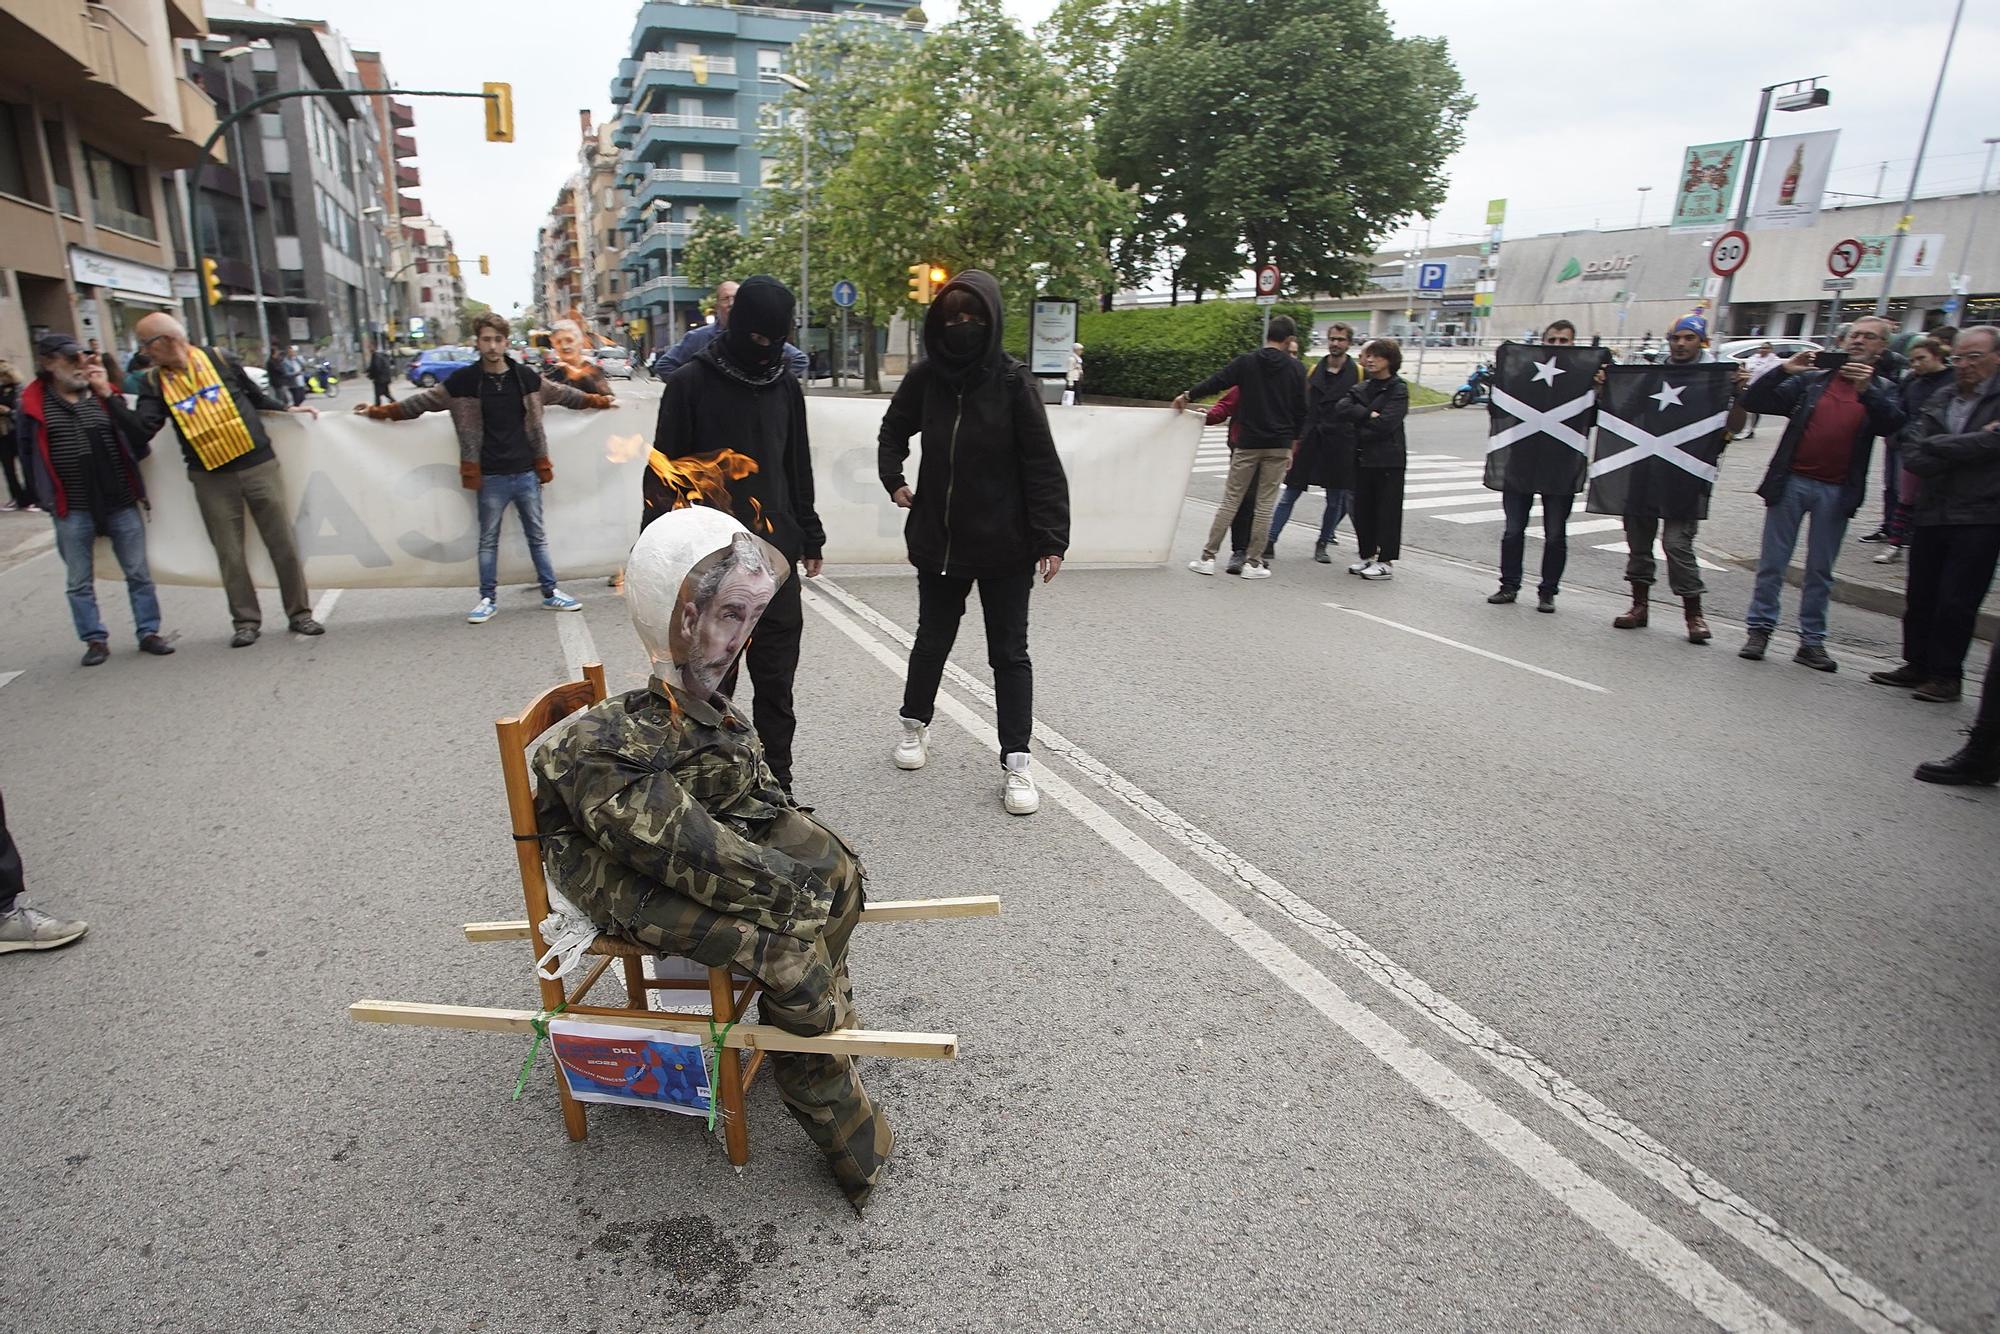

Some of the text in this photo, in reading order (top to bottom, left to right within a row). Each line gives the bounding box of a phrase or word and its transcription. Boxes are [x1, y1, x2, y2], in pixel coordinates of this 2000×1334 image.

[1717, 245, 1740, 261] 30
[1423, 266, 1442, 288] P
[612, 1047, 637, 1055] DEL
